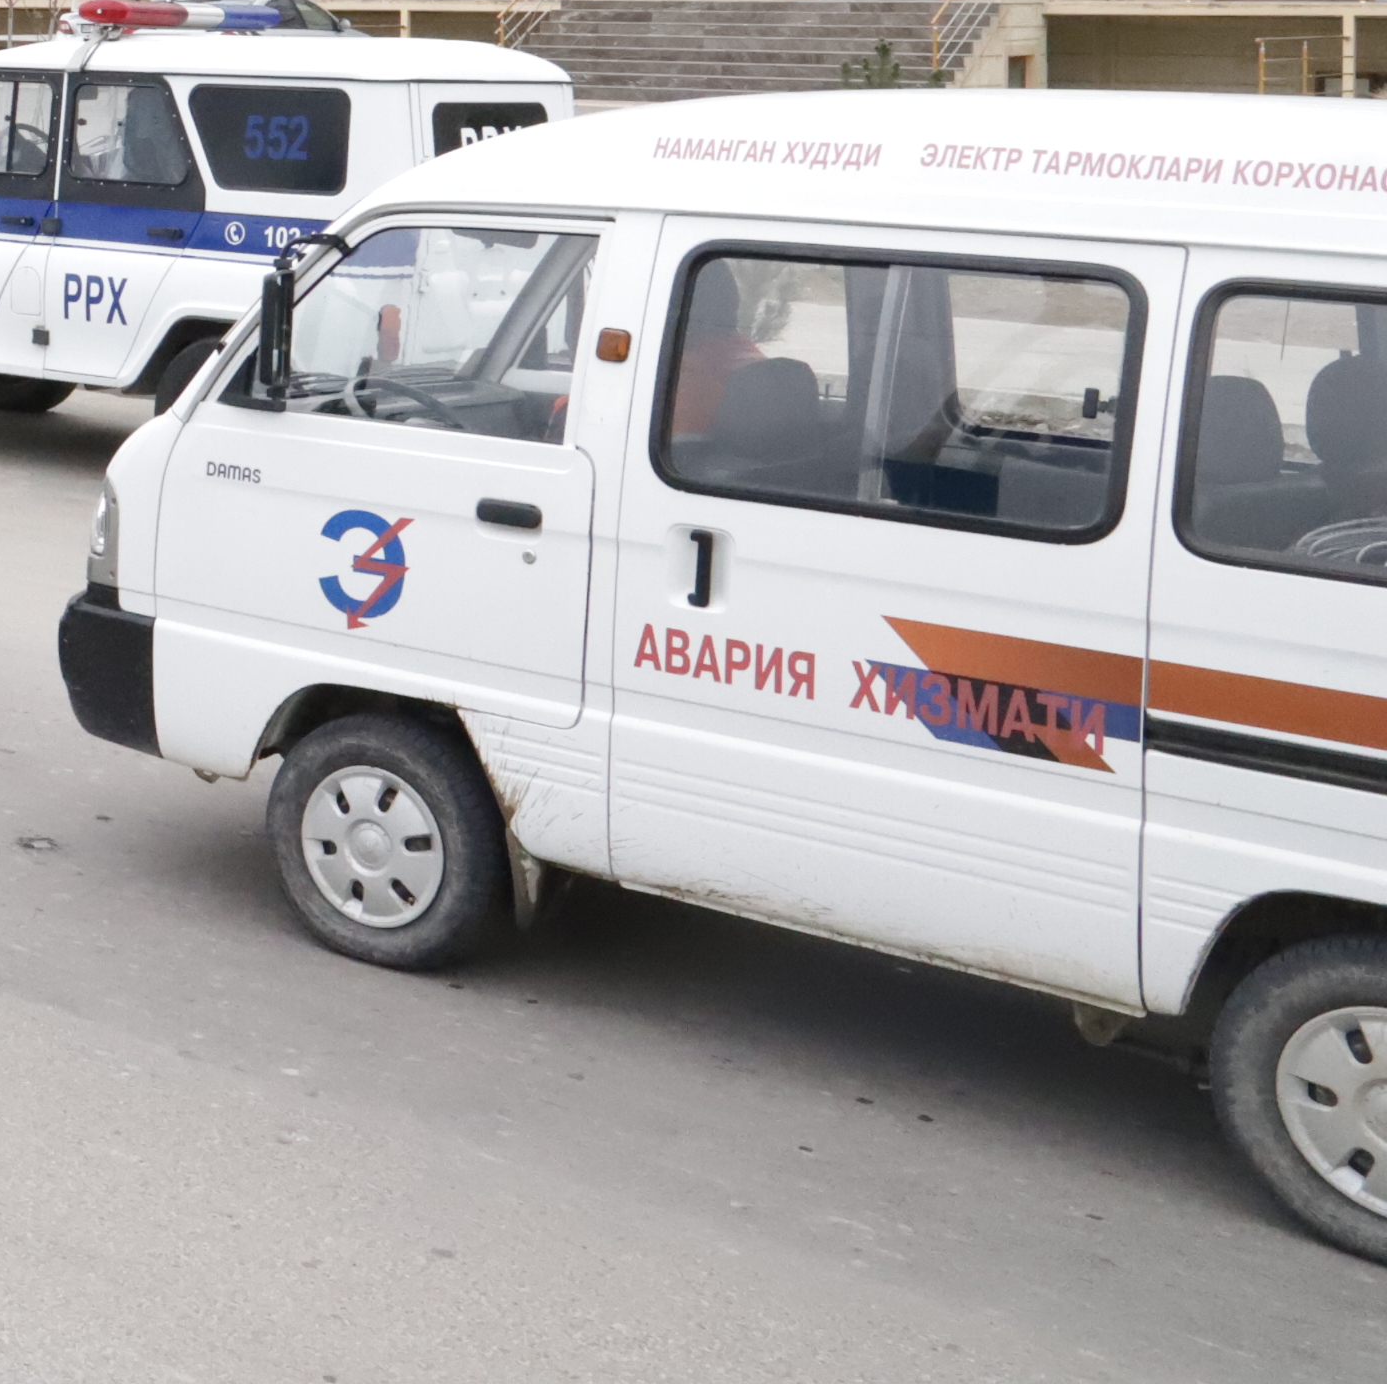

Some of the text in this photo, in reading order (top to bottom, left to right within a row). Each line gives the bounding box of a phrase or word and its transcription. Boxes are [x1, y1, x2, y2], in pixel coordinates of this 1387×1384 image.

[243, 114, 311, 160] 552
[653, 137, 776, 163] НАМАНГАН
[781, 140, 882, 171] ХУДУДИ
[919, 143, 1023, 171] ЭЛЕКТР
[1032, 148, 1224, 185] ТАРМОКЛАРИ
[264, 225, 301, 249] 102
[64, 273, 128, 325] PPX
[206, 461, 262, 484] DAMAS
[634, 623, 1106, 756] АВАРИЯ ХИЗМАТИ
